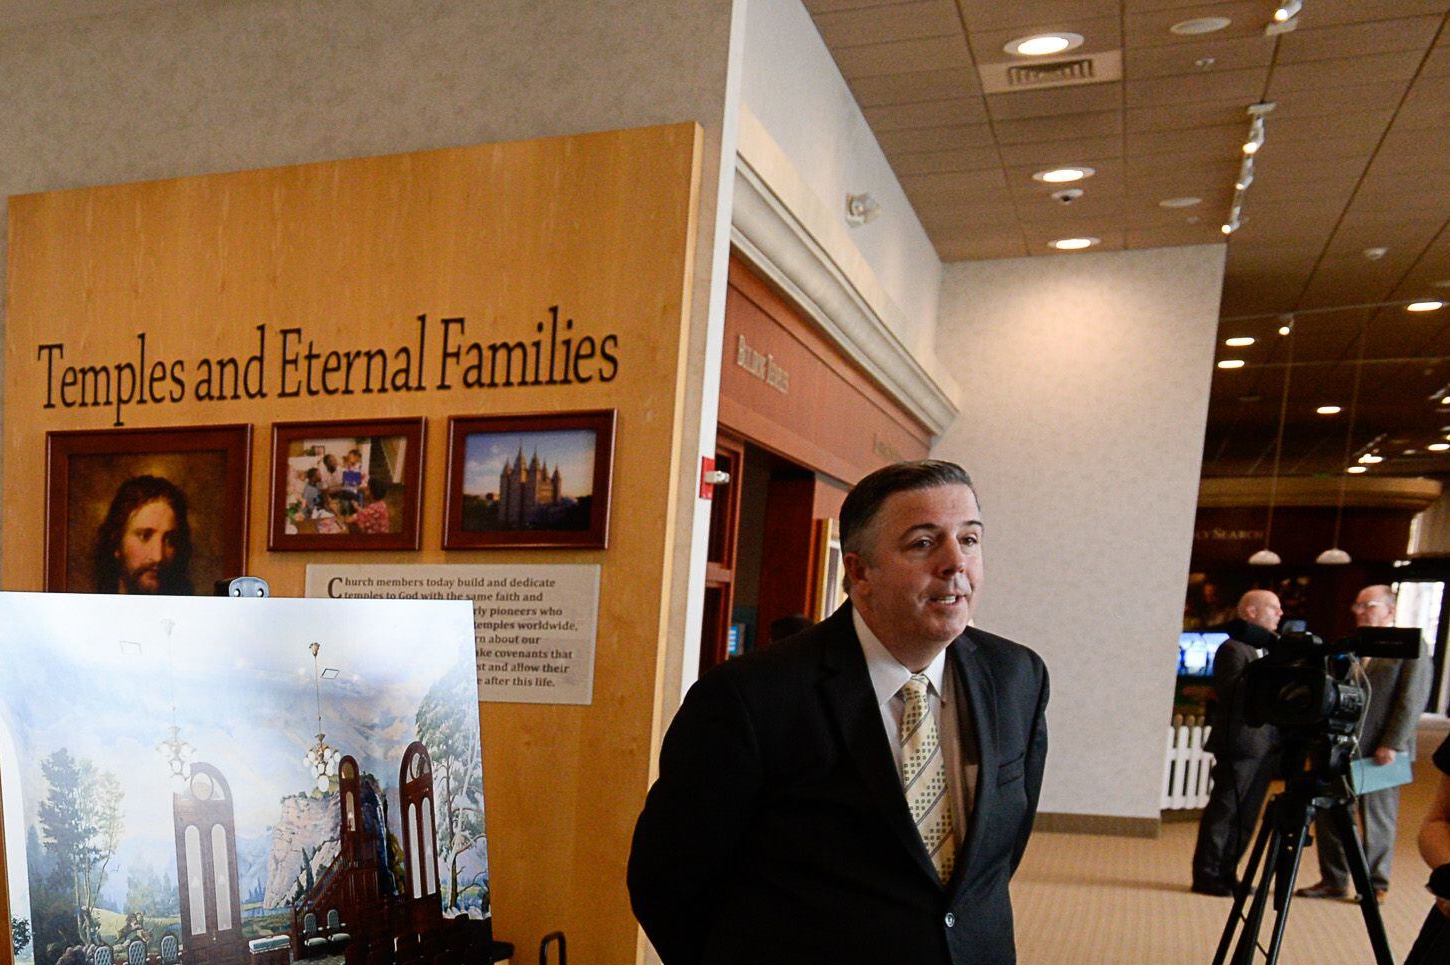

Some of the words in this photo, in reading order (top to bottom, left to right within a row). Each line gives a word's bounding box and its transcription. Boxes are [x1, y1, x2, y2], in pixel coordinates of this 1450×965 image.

[38, 333, 185, 427] Temples
[195, 324, 266, 402] and
[277, 314, 427, 399] Eternal
[436, 305, 618, 391] Families
[327, 577, 374, 599] Church
[376, 578, 424, 588] members
[426, 577, 454, 590] today
[457, 576, 485, 588] build
[487, 577, 508, 588] and
[509, 577, 556, 588] dedicate
[344, 590, 384, 600] temples
[386, 591, 397, 600] to
[399, 590, 419, 600] God
[420, 590, 444, 600] with
[446, 590, 464, 600] the
[466, 592, 494, 601] same
[495, 590, 520, 601] faith
[523, 591, 544, 601] and
[473, 606, 486, 618] rly
[489, 606, 537, 618] pioneers
[539, 606, 563, 616] who
[473, 620, 515, 632] temples
[517, 620, 579, 632] worldwide,
[488, 634, 519, 645] about
[522, 636, 542, 645] our
[494, 650, 549, 659] covenants
[550, 649, 573, 660] that
[487, 662, 508, 673] and
[510, 662, 540, 673] allow
[542, 663, 570, 674] their
[484, 676, 510, 687] after
[512, 677, 533, 687] this
[535, 677, 556, 688] life.
